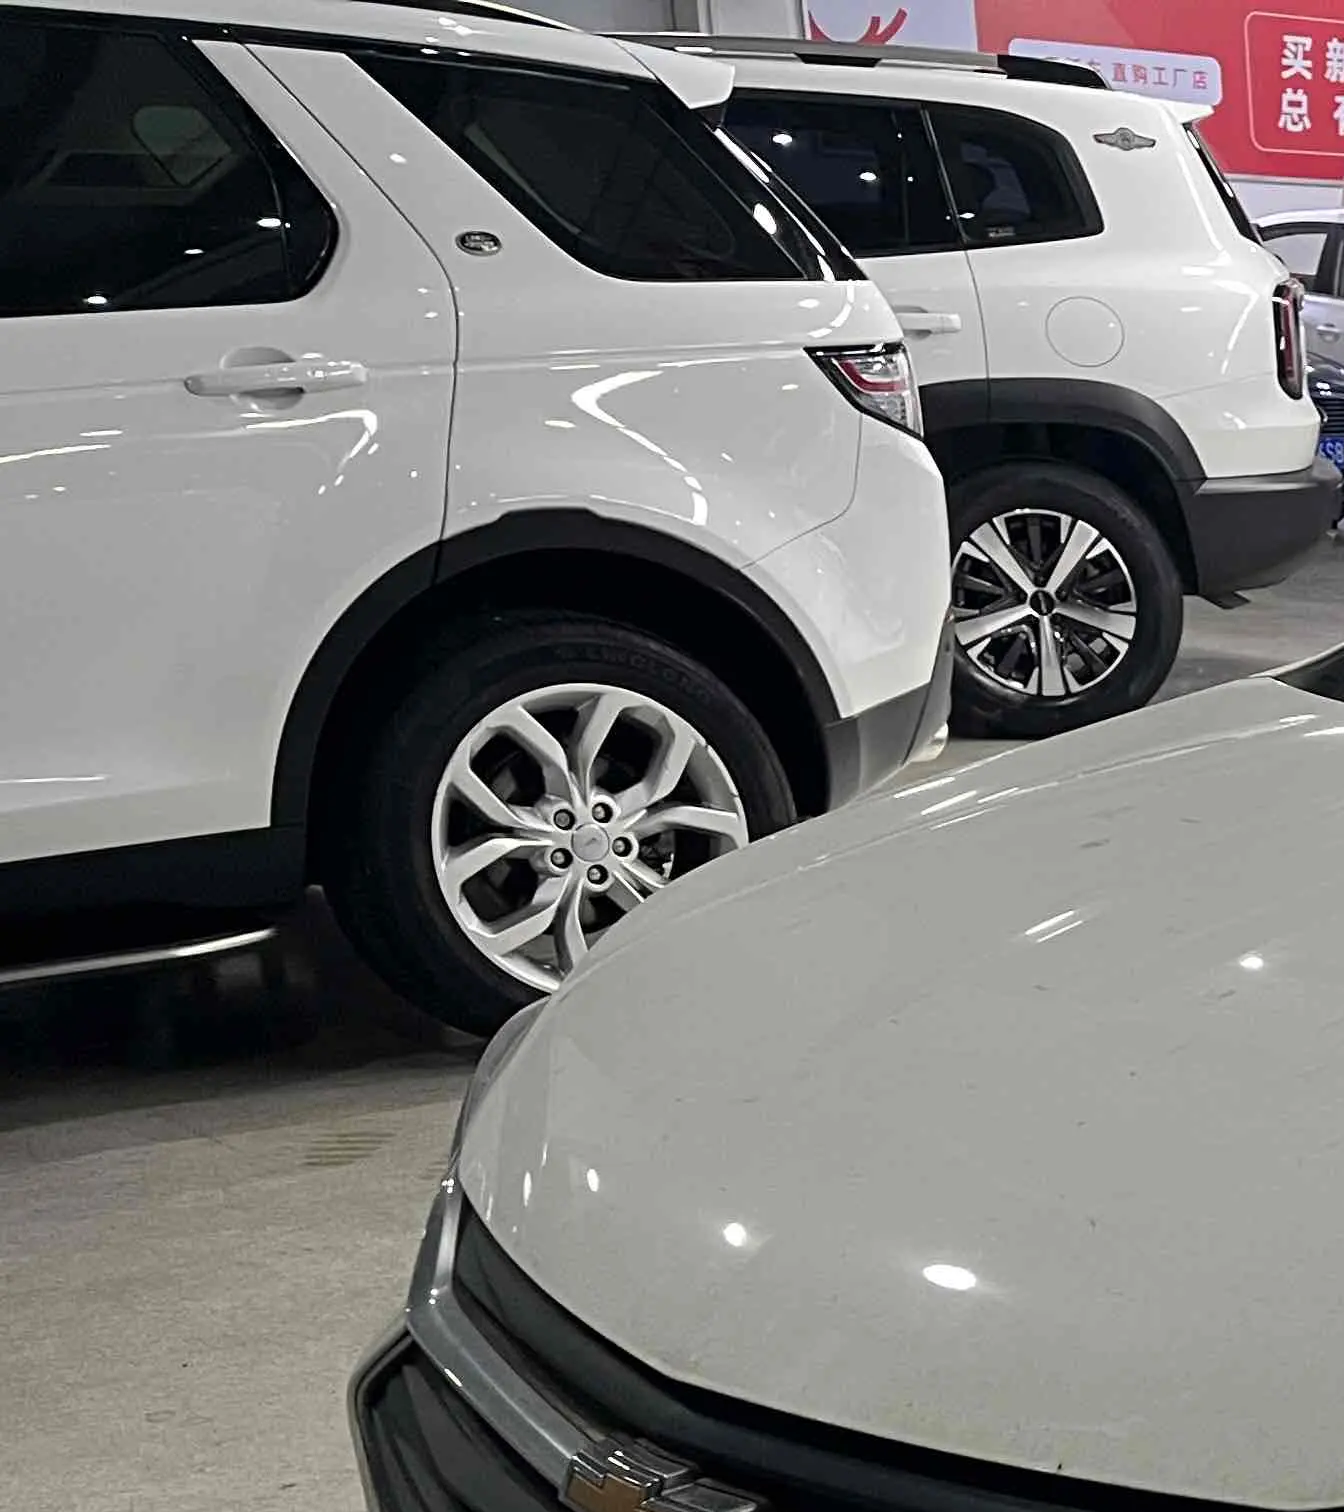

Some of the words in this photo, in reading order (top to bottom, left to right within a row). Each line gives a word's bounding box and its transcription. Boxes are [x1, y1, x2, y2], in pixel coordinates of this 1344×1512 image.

[1111, 62, 1209, 91] 直购工厂店
